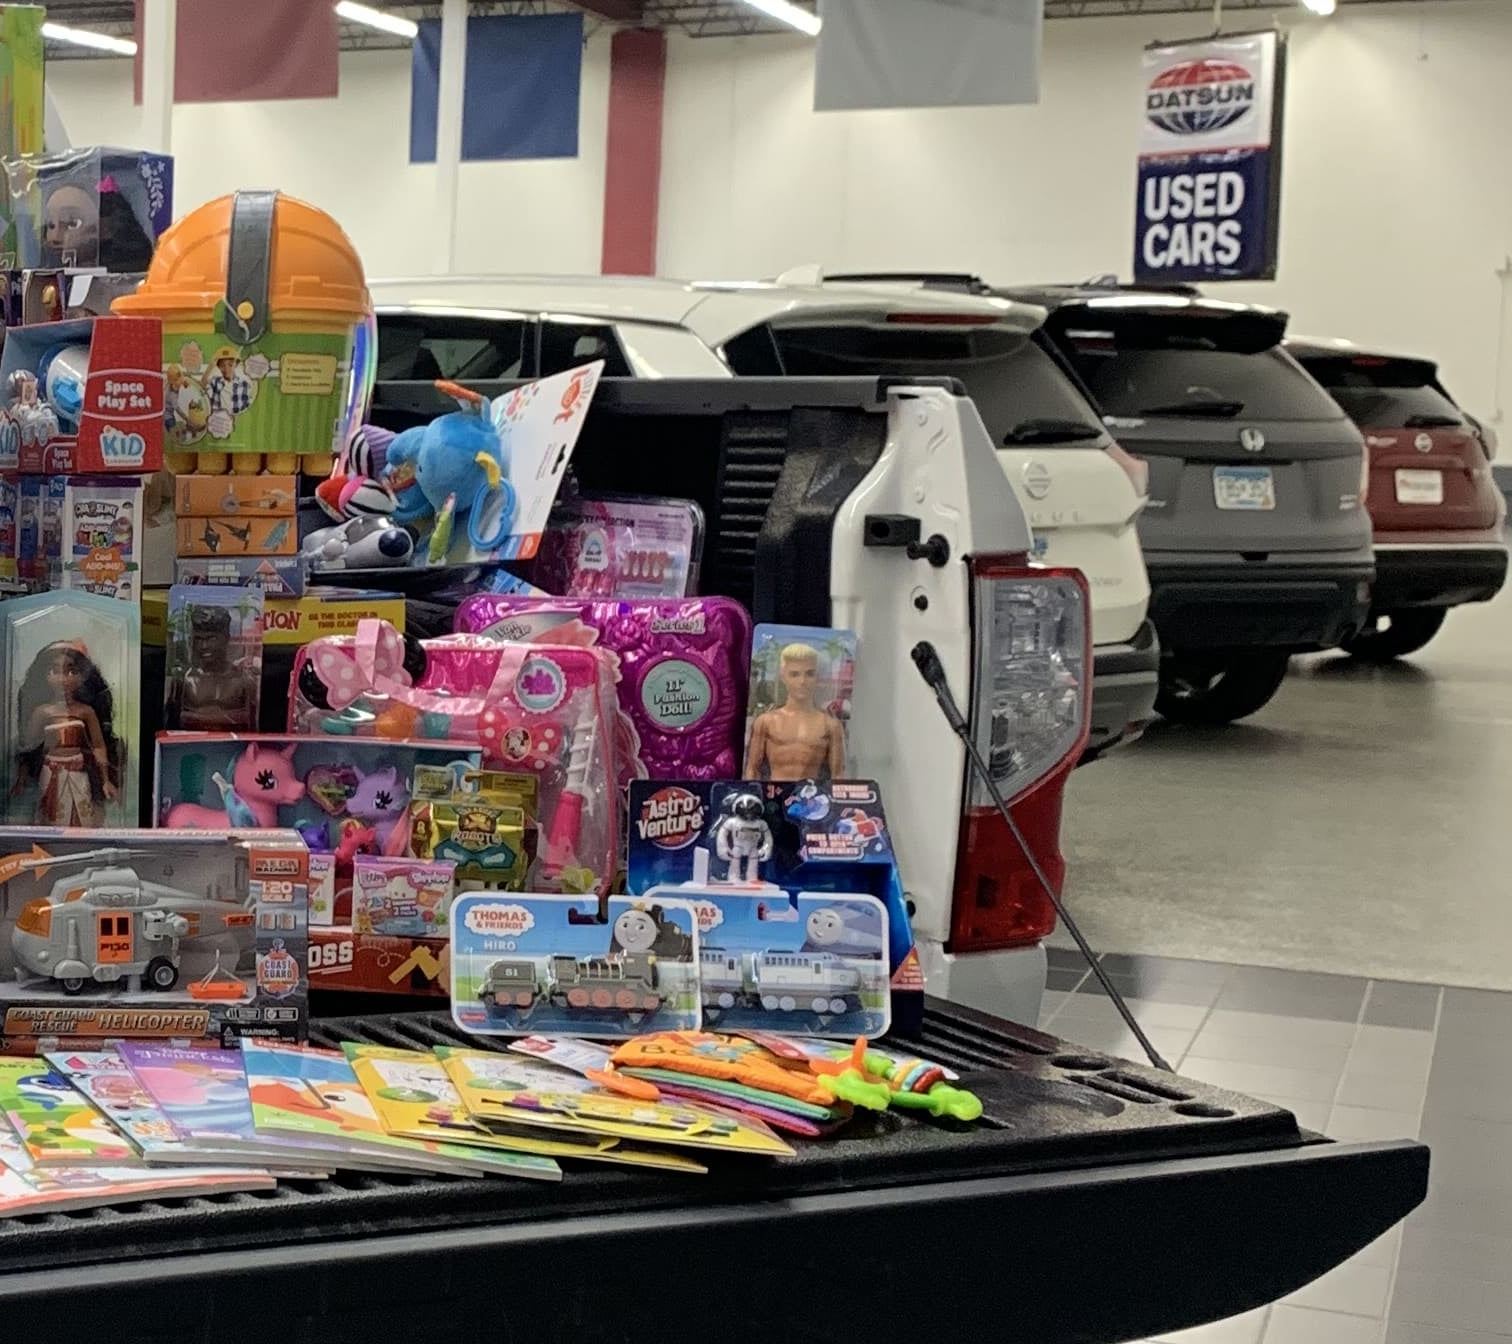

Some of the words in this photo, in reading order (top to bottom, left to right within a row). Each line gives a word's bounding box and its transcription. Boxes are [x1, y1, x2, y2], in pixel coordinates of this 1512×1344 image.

[1147, 82, 1254, 110] DATSUN
[1144, 171, 1245, 221] USED
[1142, 219, 1242, 268] CARS
[105, 380, 144, 394] Space
[98, 396, 126, 410] Play
[130, 396, 152, 408] Set
[103, 434, 144, 456] KID
[642, 796, 701, 819] Astro
[637, 812, 706, 840] Venture
[472, 909, 527, 922] THOMAS
[484, 921, 524, 931] FRIENDS
[309, 940, 354, 968] OSS
[483, 940, 517, 952] HIRO
[13, 1009, 51, 1022] COAST
[53, 1009, 96, 1022] GUARD
[97, 1013, 205, 1033] HELICOPTER
[32, 1021, 79, 1033] RESCUE
